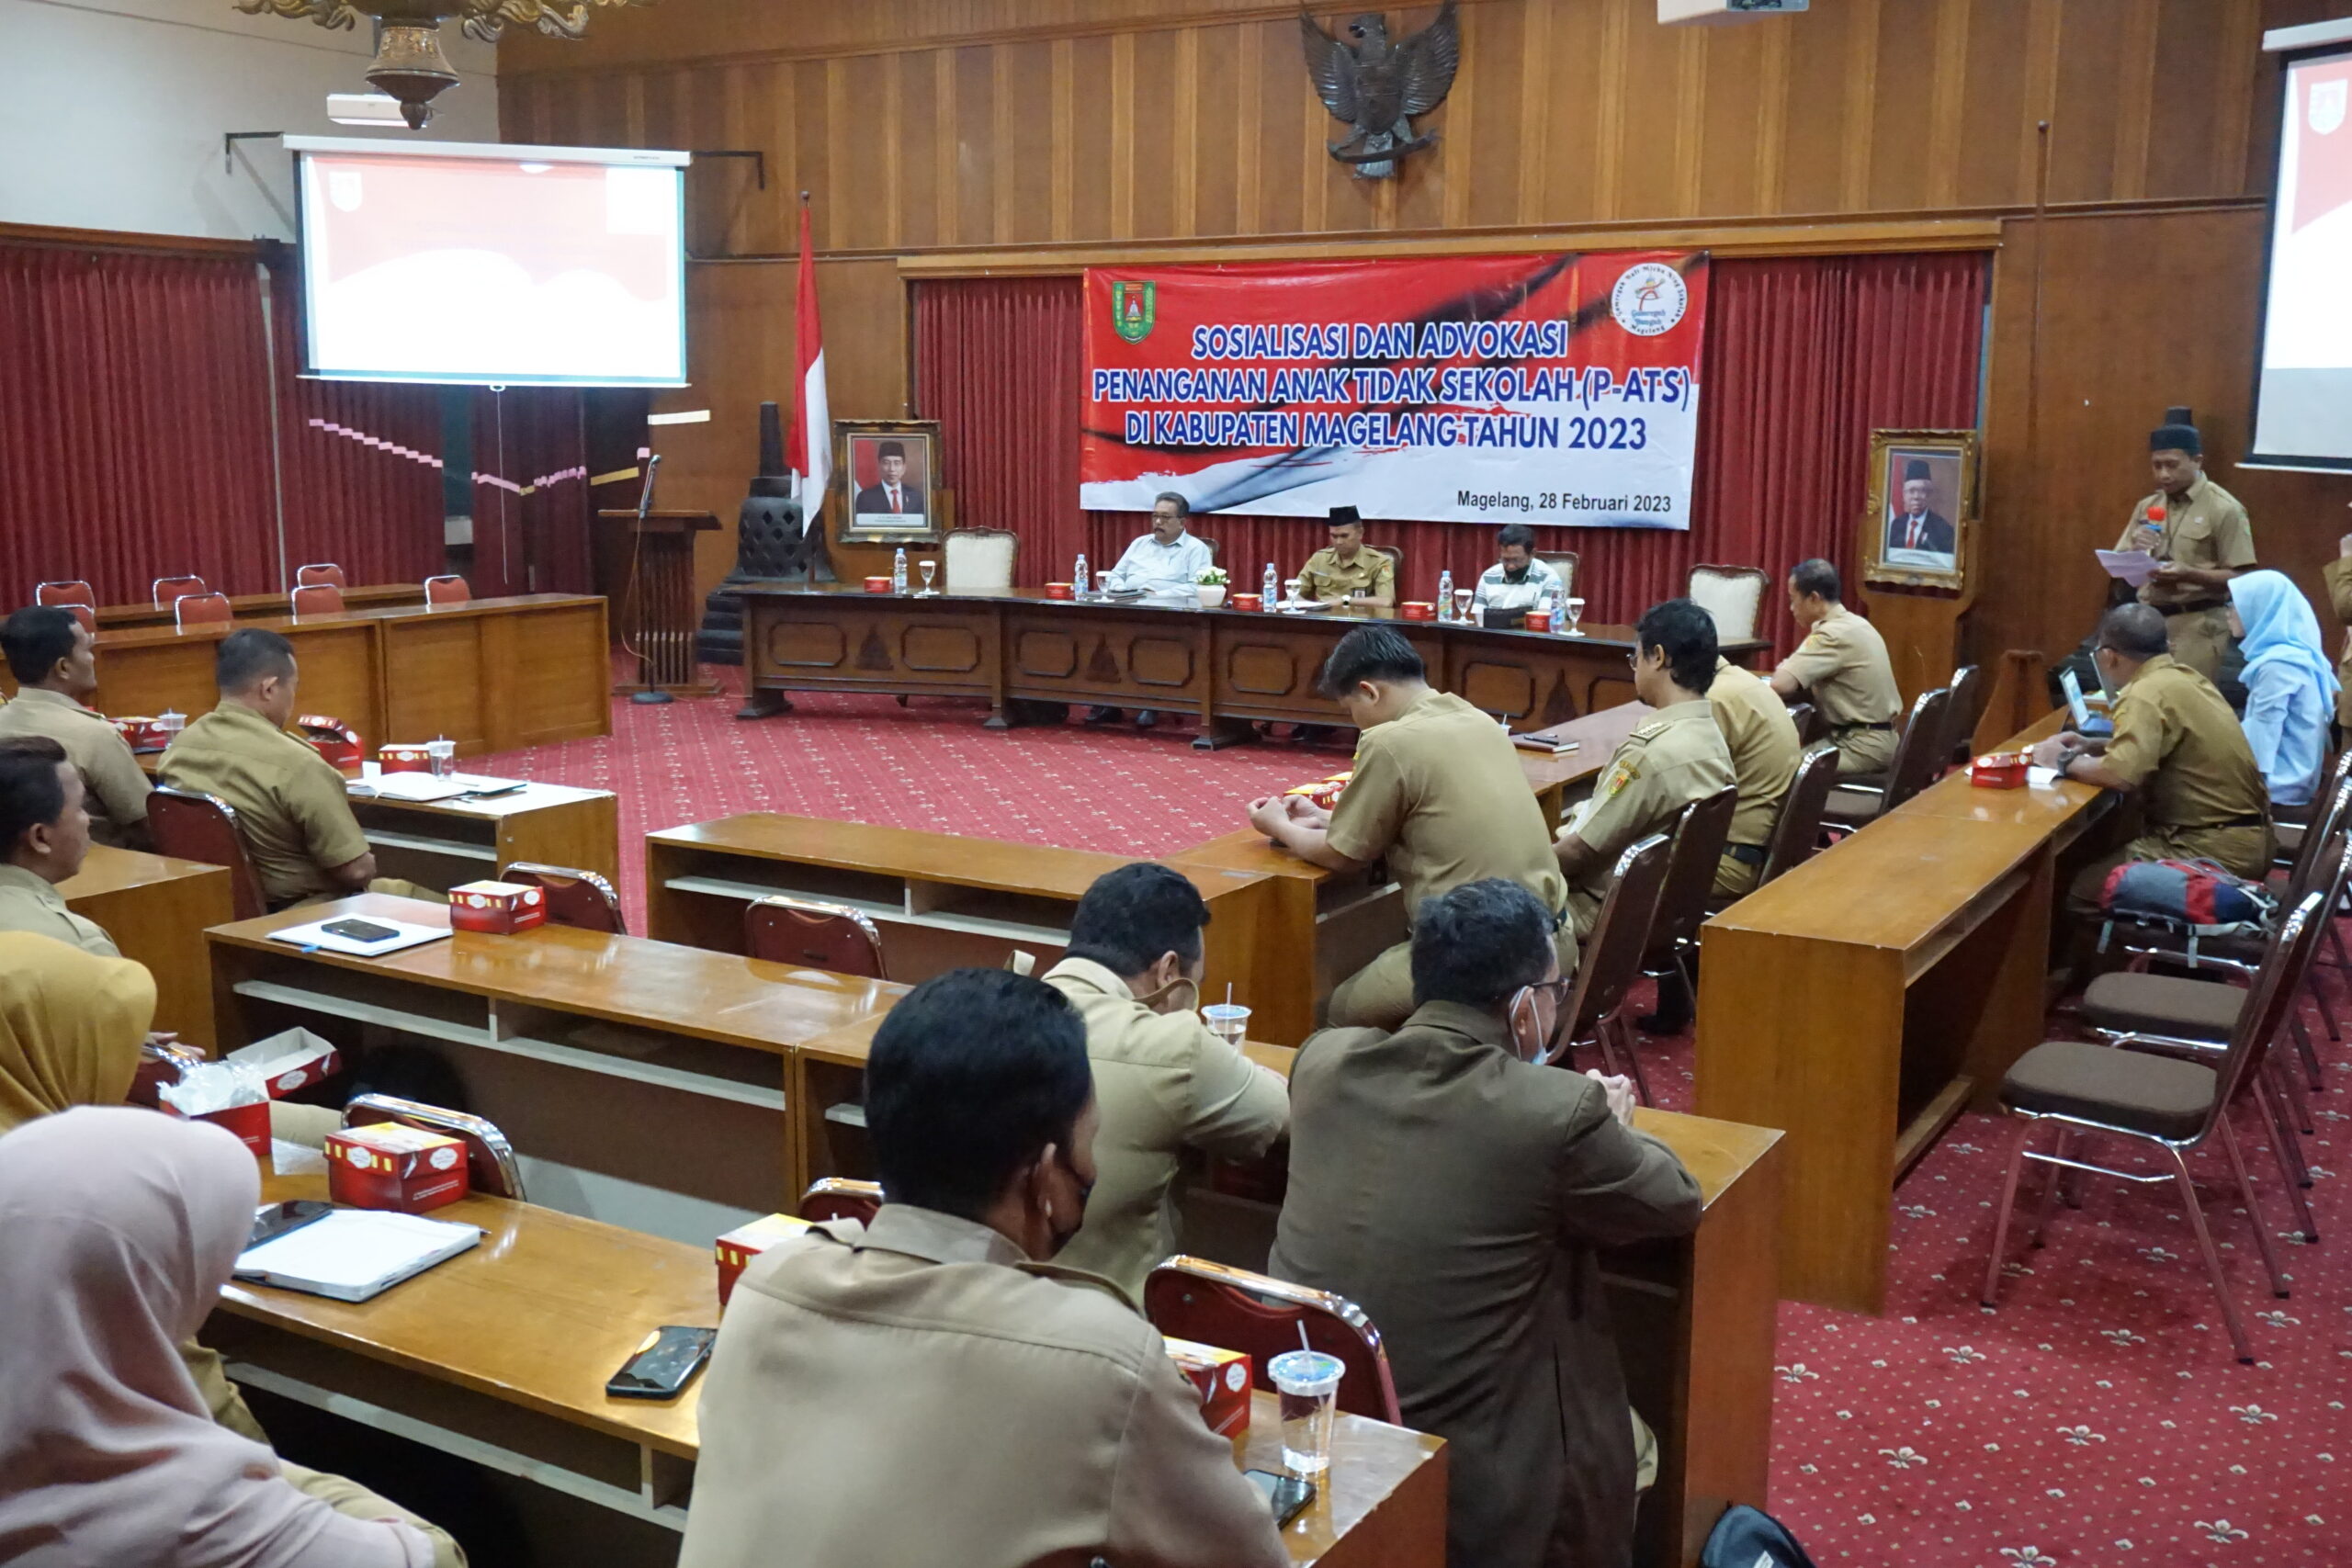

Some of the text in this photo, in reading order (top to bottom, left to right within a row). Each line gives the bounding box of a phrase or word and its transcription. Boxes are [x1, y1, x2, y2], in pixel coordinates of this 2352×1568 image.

[1193, 322, 1567, 358] SOSIALISASI DAN ADVOKASI
[1093, 367, 1690, 412] PENANGANAN ANAK TIDAK SEKOLAH (P-ATS)
[1126, 412, 1646, 450] DI KABUPATEN MAGELANG TAHUN 2023
[1457, 491, 1672, 513] Magelang, 28 Februari 2023
